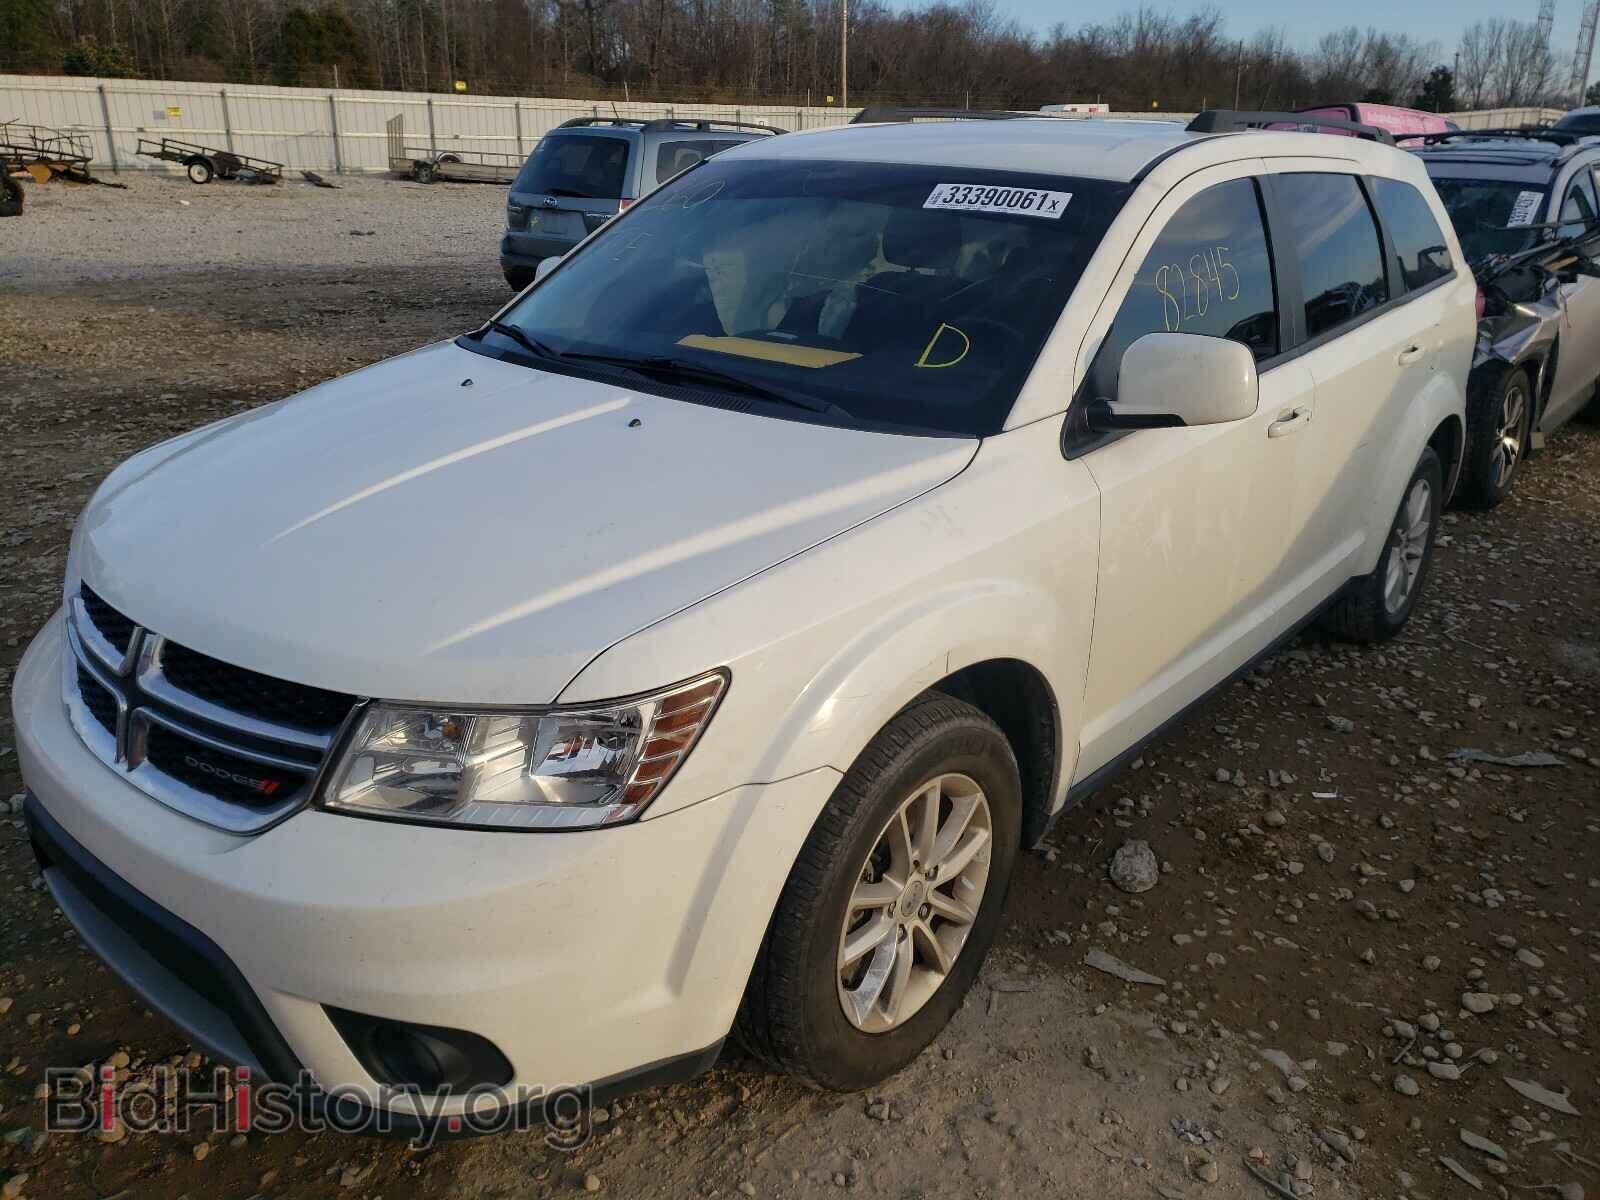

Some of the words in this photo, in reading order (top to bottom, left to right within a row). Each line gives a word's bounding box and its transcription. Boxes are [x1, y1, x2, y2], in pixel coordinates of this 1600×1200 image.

[942, 185, 1049, 211] 33390061
[1155, 246, 1240, 332] 82845
[913, 322, 970, 368] D
[184, 755, 263, 791] DODGE
